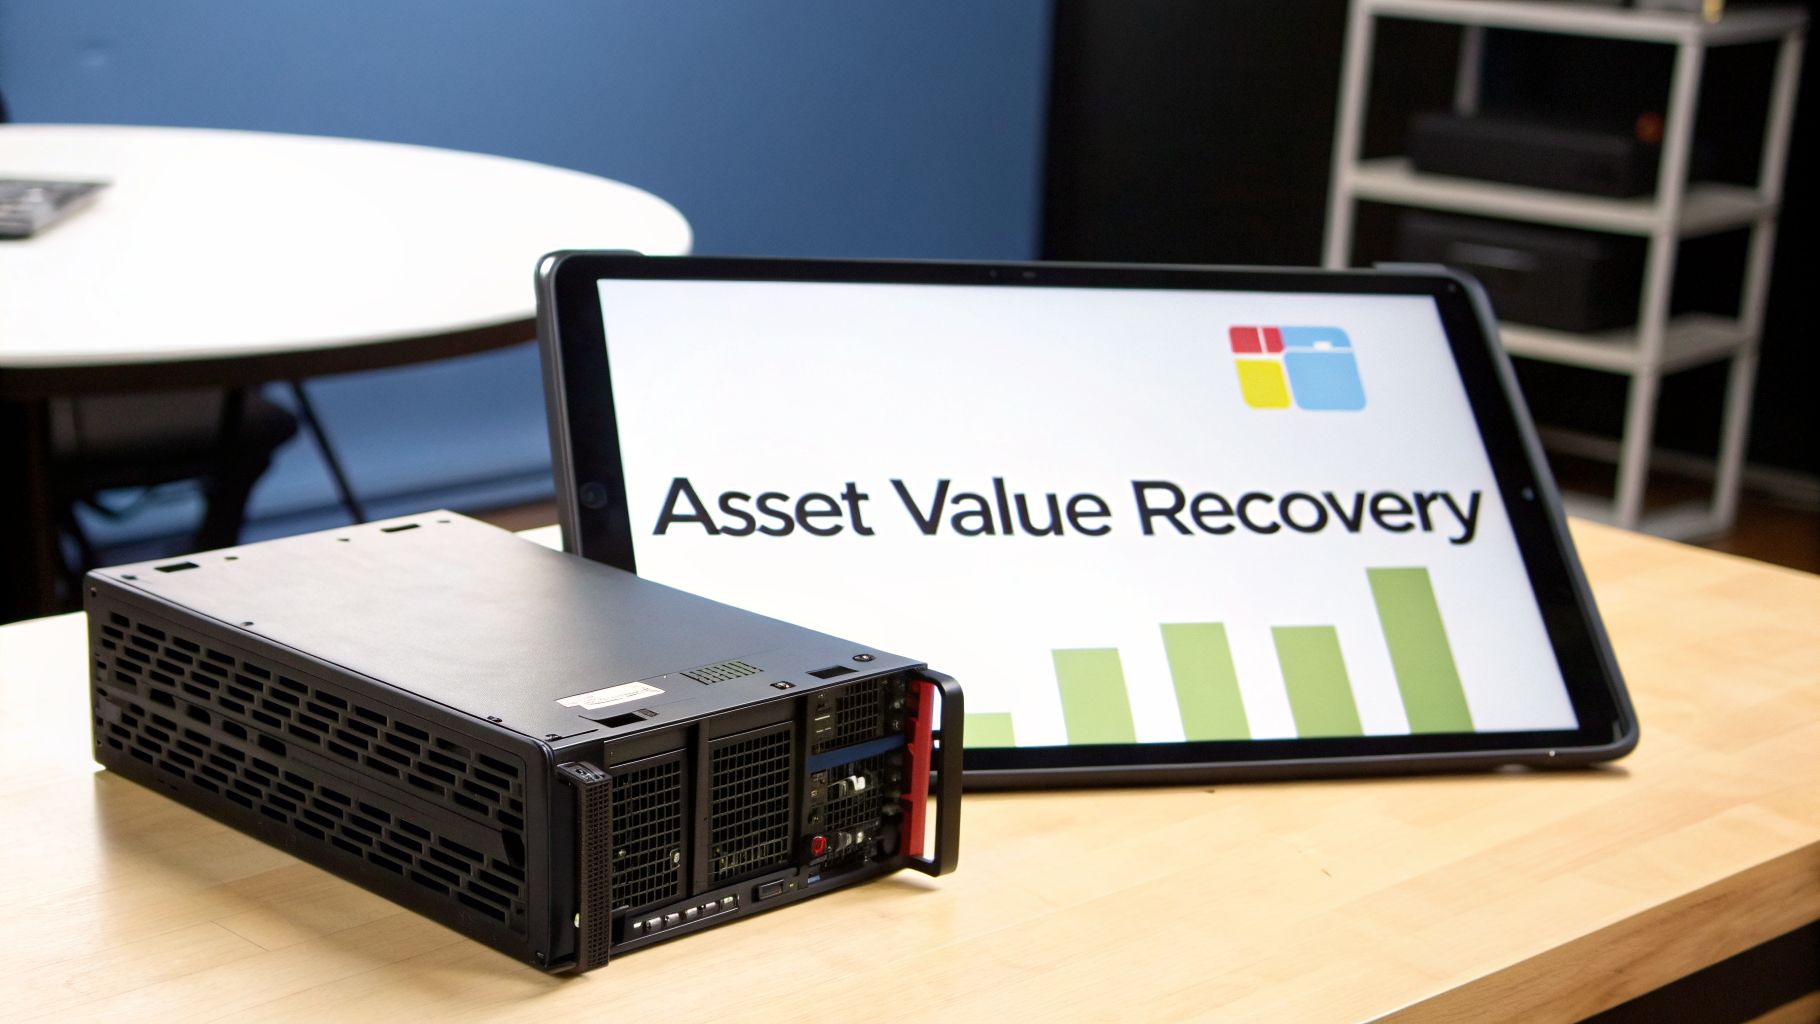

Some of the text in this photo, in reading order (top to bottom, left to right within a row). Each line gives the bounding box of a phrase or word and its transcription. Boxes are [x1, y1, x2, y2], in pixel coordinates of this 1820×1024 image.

[653, 477, 1484, 545] Asset Value Recovery
